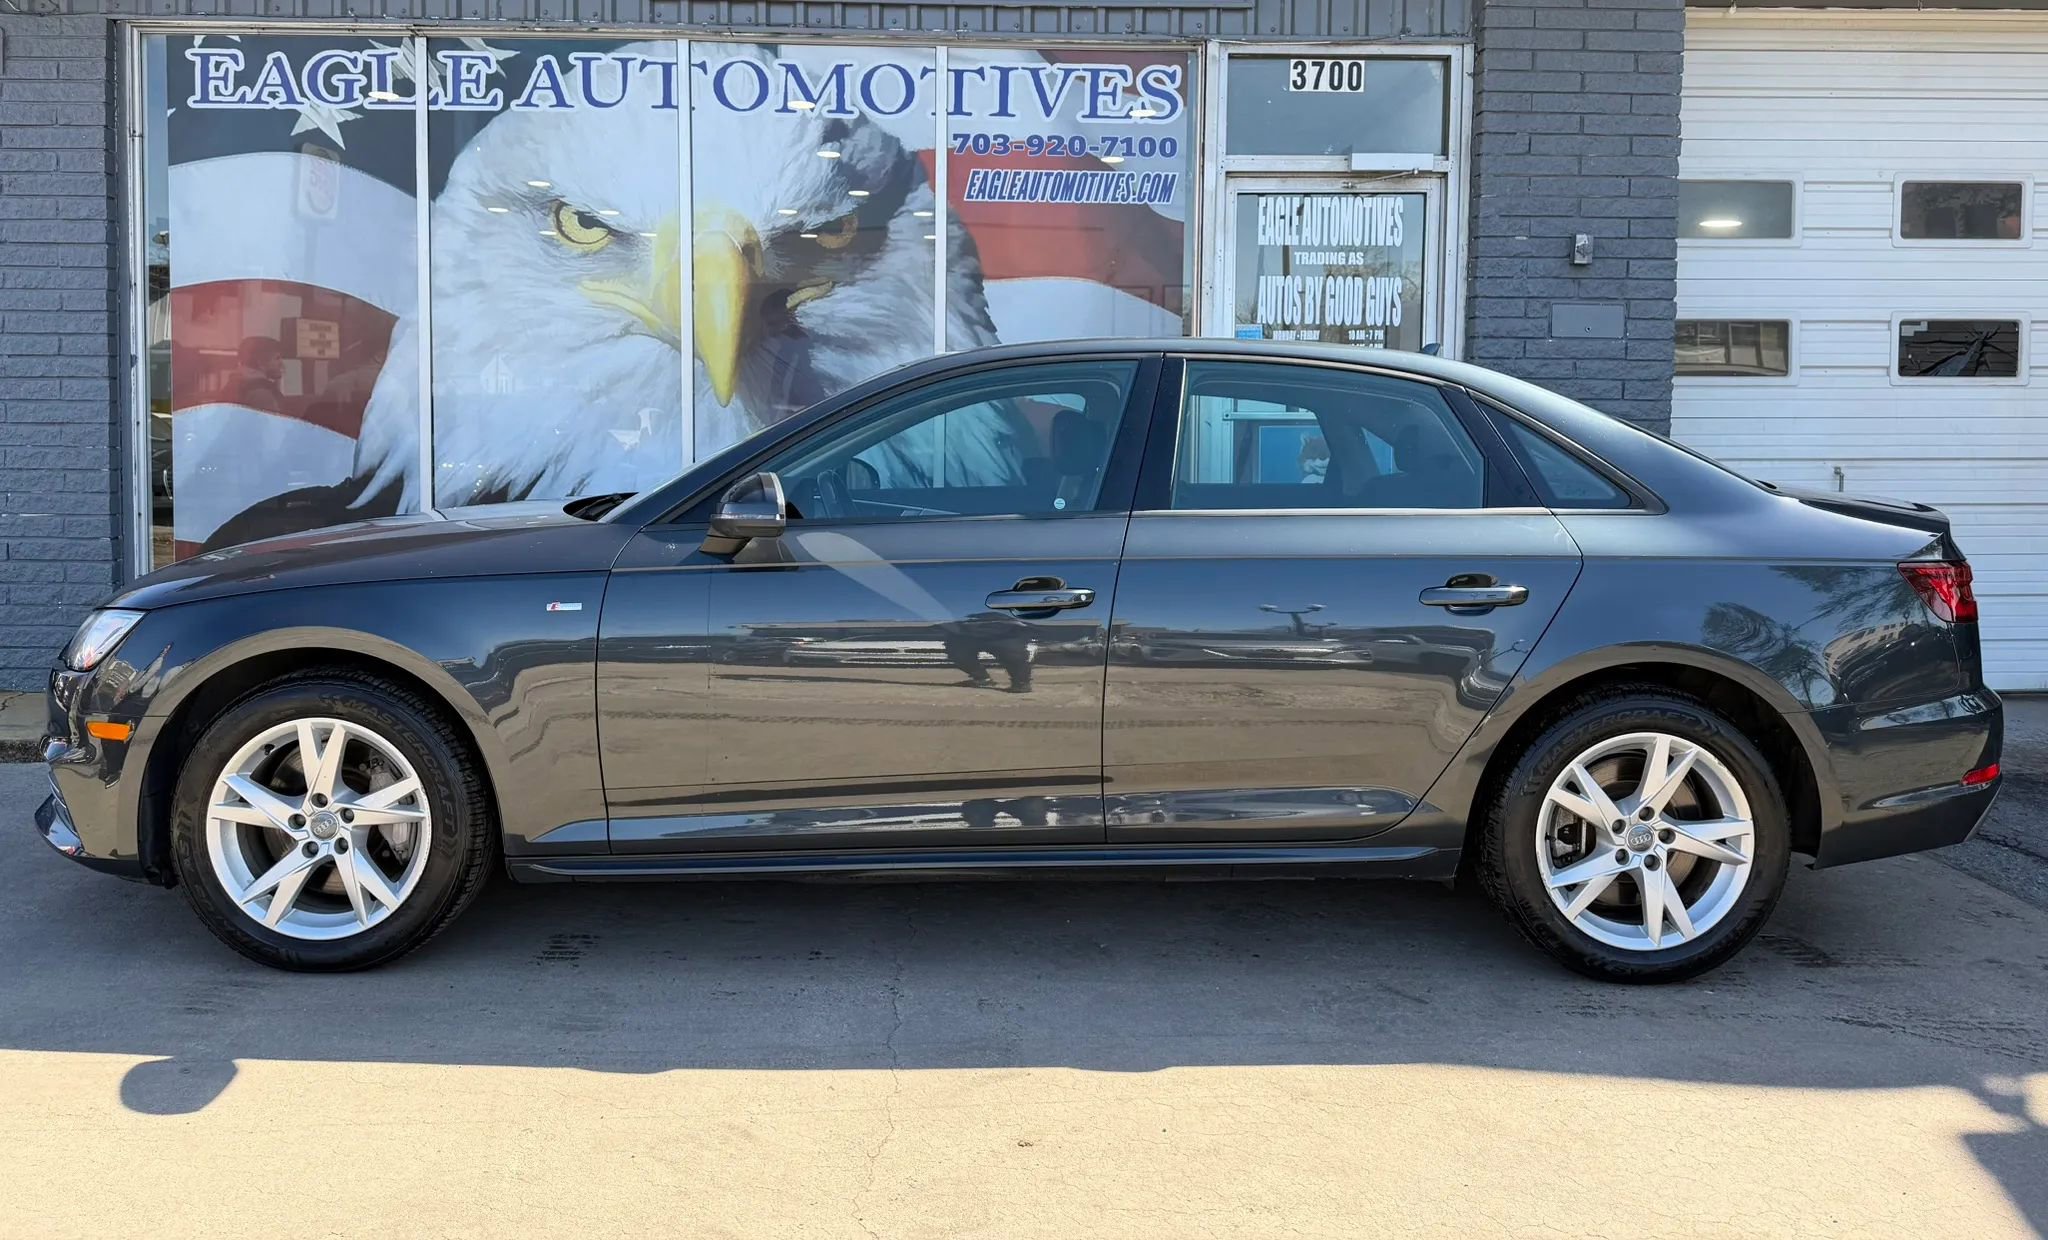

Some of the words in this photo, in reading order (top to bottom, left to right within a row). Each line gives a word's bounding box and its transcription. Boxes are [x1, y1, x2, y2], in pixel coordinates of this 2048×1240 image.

[187, 48, 503, 111] EAGLE
[511, 52, 1184, 125] AUTOMOTIVES
[1291, 60, 1363, 91] 3700
[953, 133, 1178, 158] 703-920-7100
[964, 169, 1176, 205] EAGLEAUTOMOTIVES.COM
[1257, 196, 1300, 247] EAGLE
[1301, 196, 1404, 247] AUTOMOTIVES
[1294, 251, 1346, 265] TRADING
[1347, 251, 1364, 265] AS
[1257, 275, 1302, 326] AUTOS
[1304, 276, 1324, 326] BY
[1325, 275, 1363, 327] GOOD
[1365, 276, 1402, 328] GUYS
